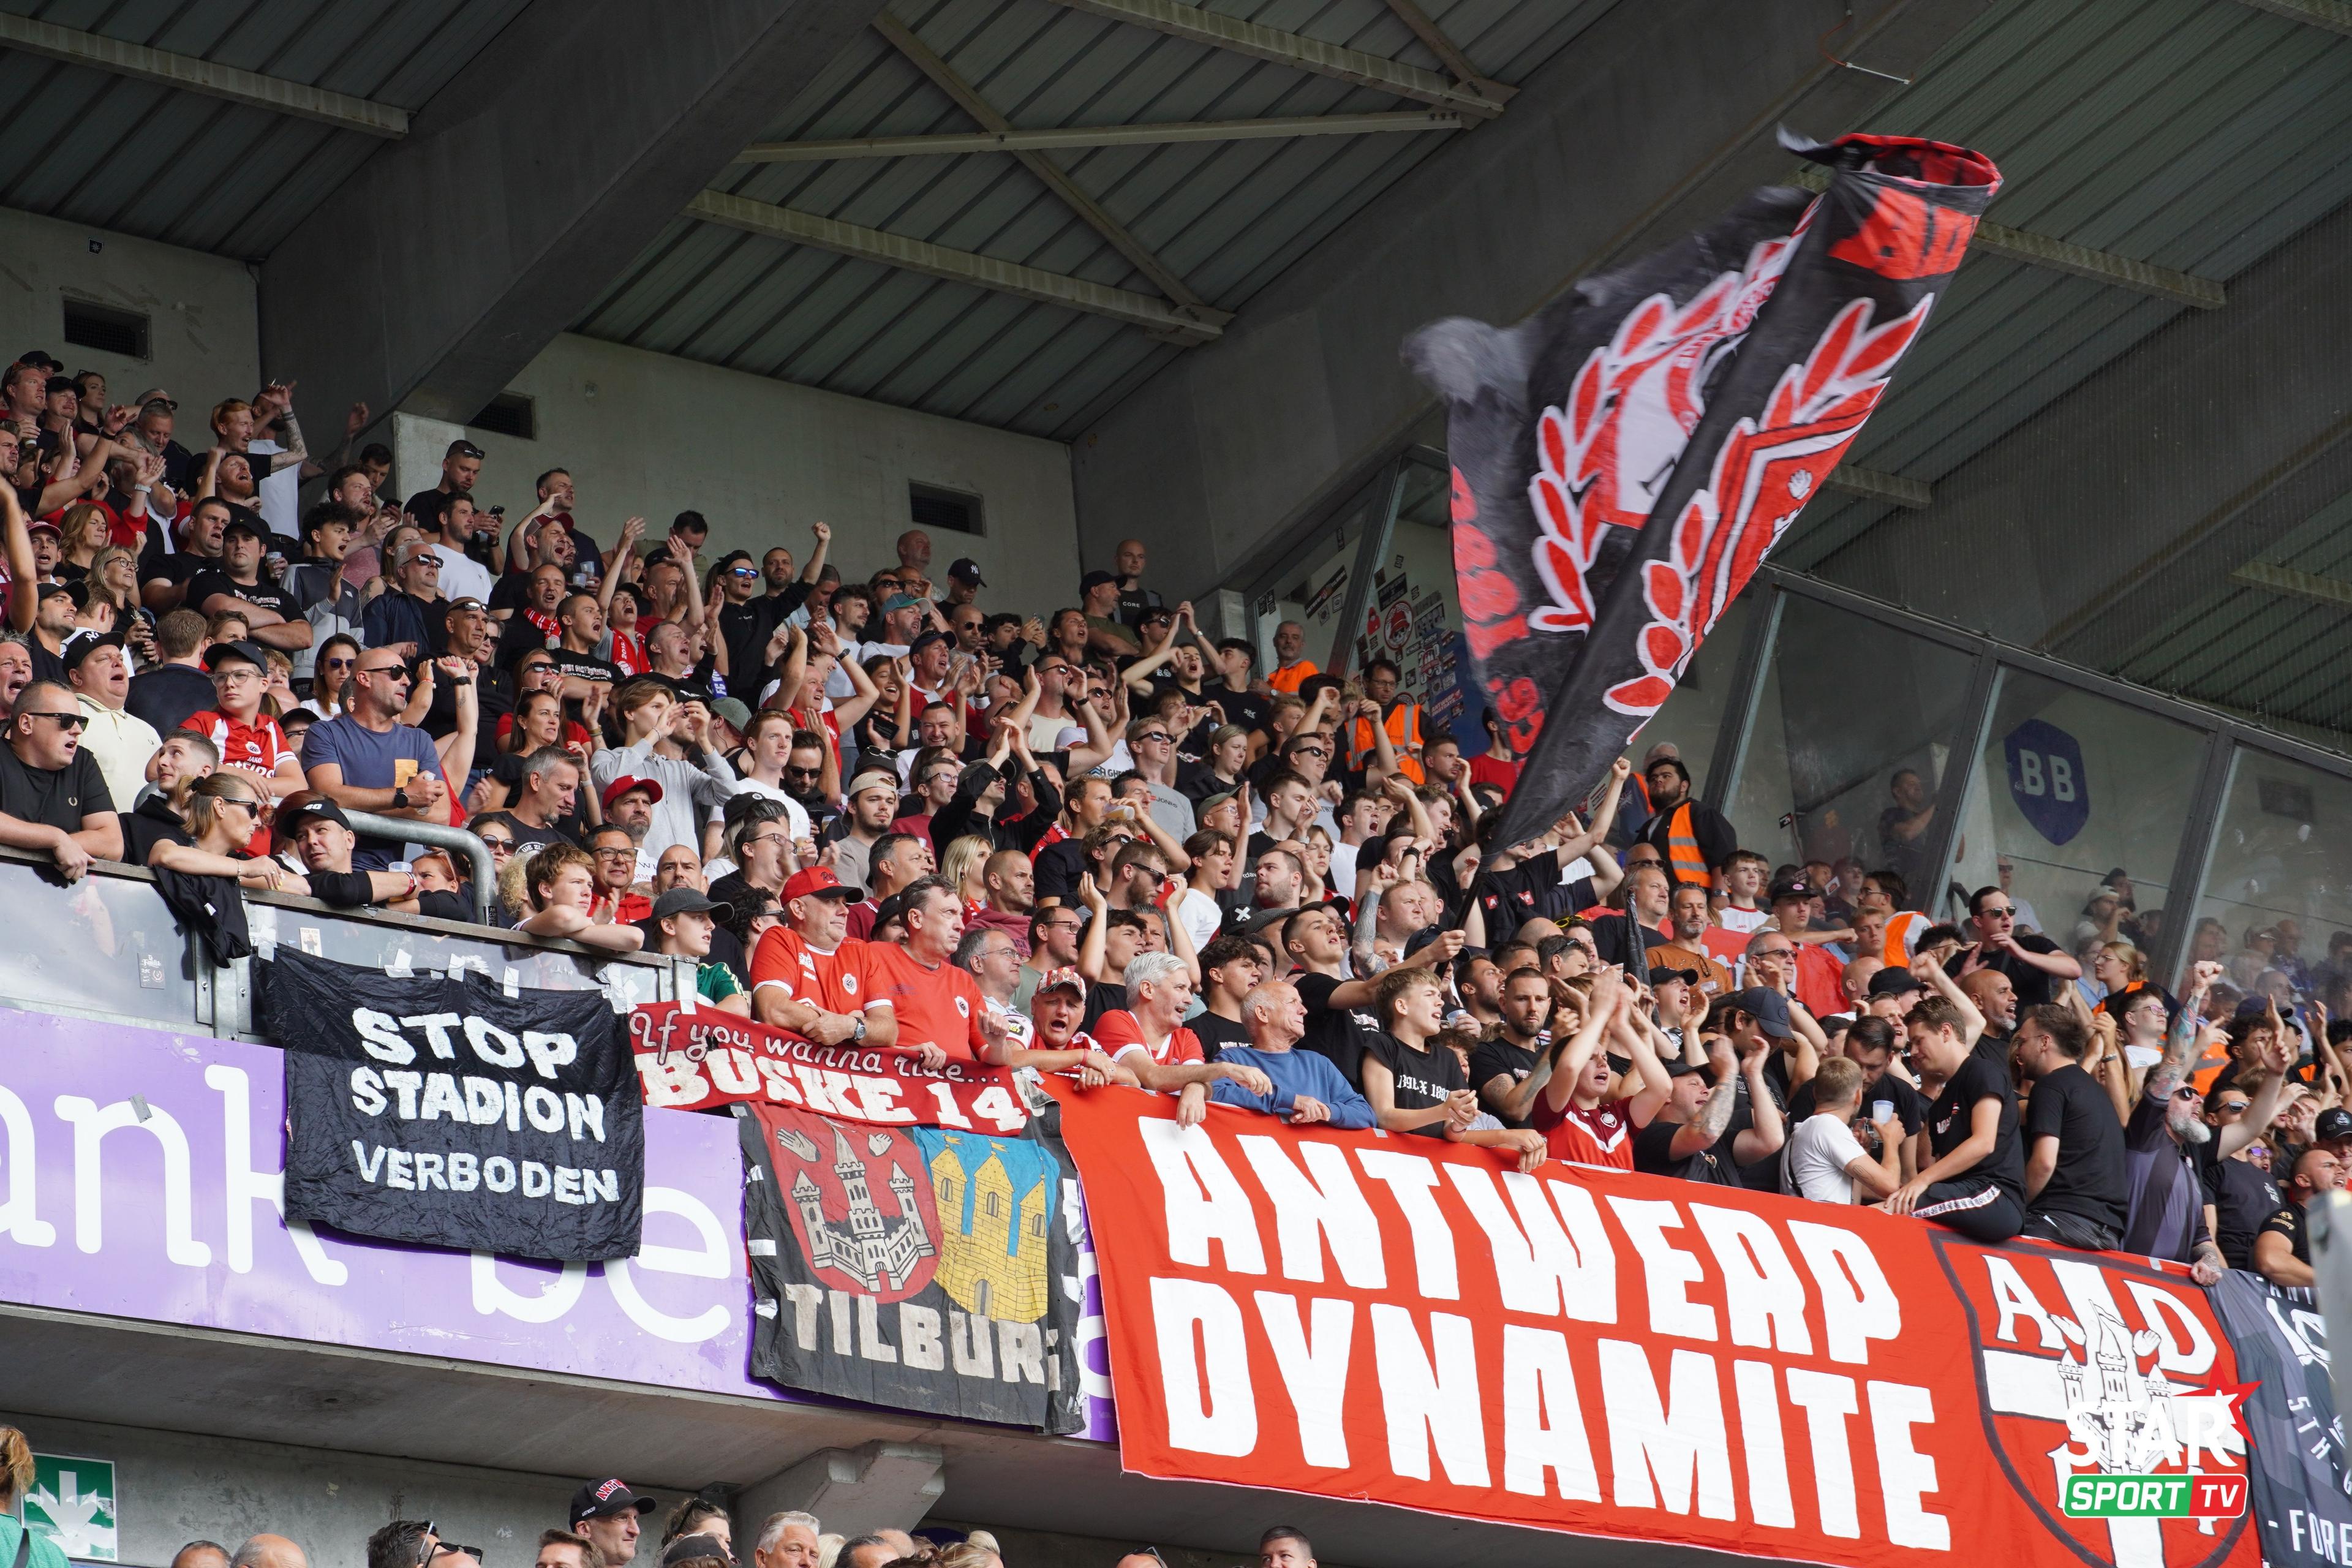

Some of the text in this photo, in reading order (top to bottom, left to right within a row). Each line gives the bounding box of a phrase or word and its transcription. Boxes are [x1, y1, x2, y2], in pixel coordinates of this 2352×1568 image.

[247, 755, 263, 764] JAKO
[2019, 748, 2075, 802] BB
[352, 1007, 578, 1079] STOP
[682, 1025, 752, 1061] you
[766, 1035, 883, 1074] wanna
[351, 1066, 606, 1144] STADION
[633, 1048, 1031, 1133] BUSKE 14
[352, 1140, 620, 1205] VERBODEN
[1137, 1115, 1902, 1365] ANTWERP
[1150, 1276, 1951, 1551] DYNAMITE
